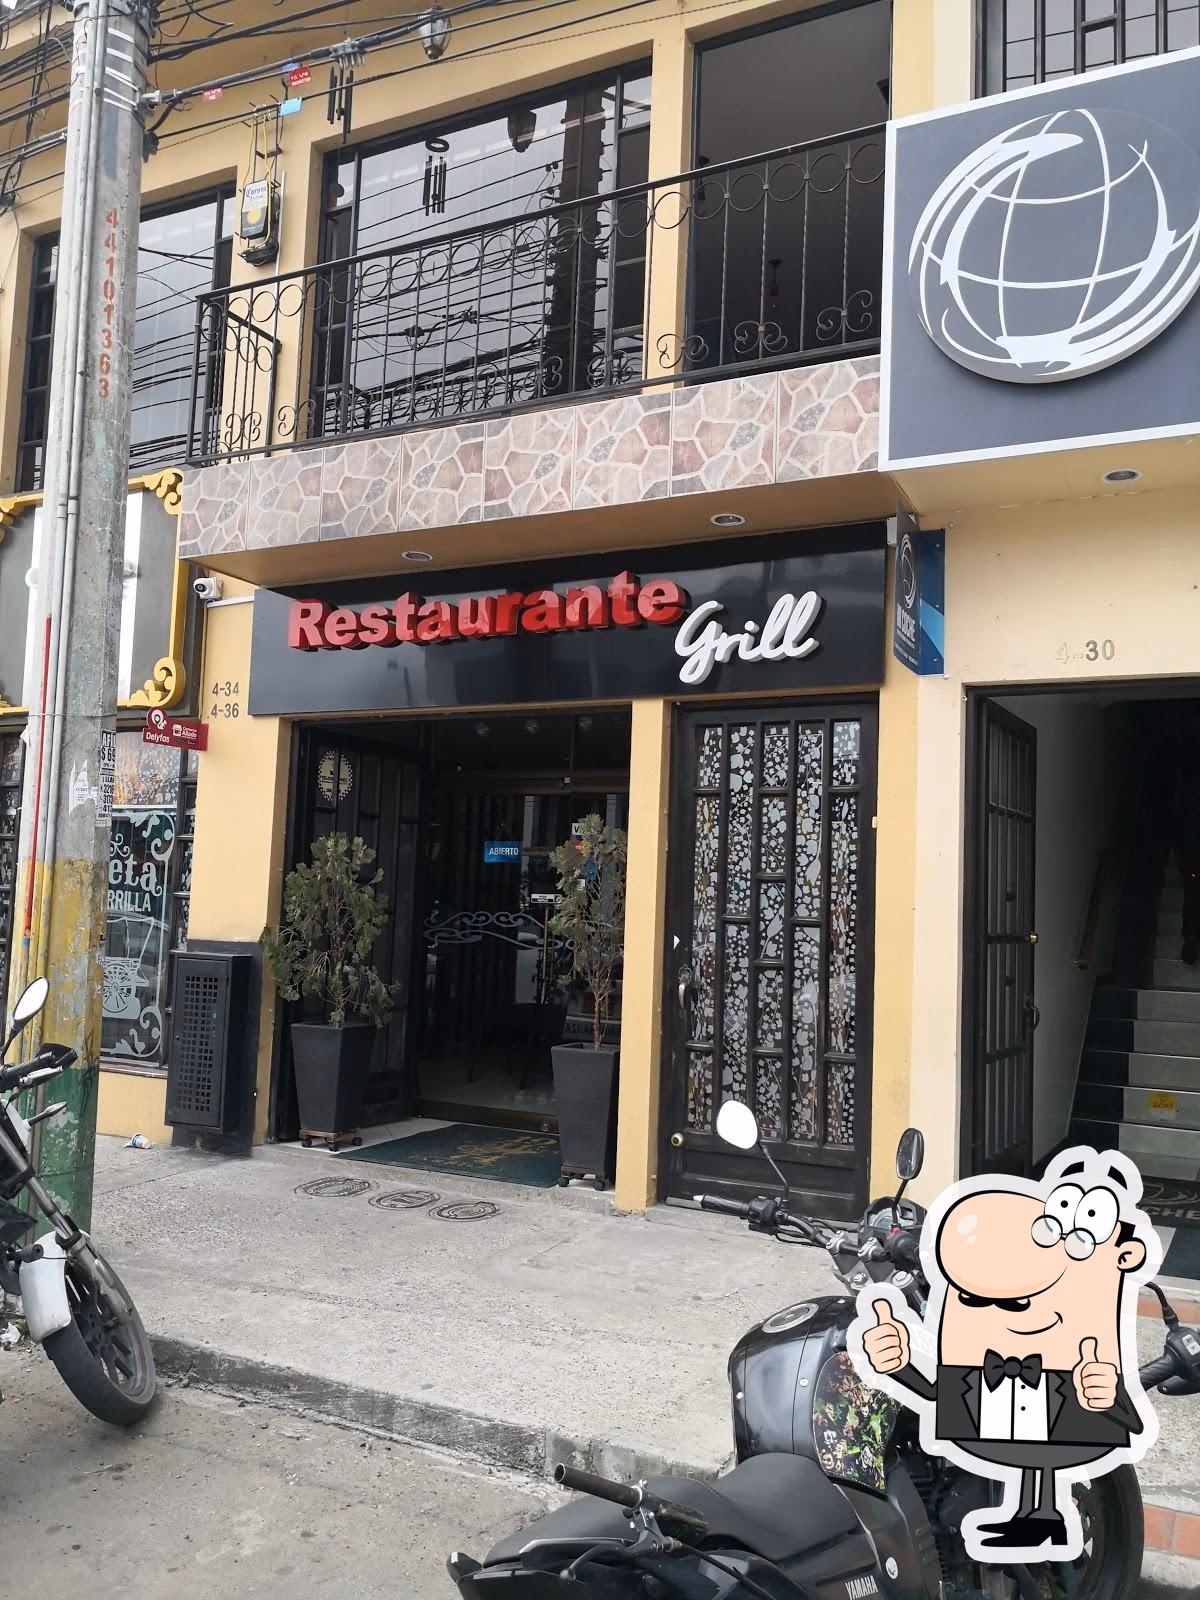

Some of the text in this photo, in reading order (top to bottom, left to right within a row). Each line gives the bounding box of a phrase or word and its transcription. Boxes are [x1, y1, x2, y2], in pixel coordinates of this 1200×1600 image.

[98, 207, 119, 400] 44101363
[287, 570, 820, 685] Restaurante Grill
[211, 681, 240, 697] 4-34
[210, 702, 240, 718] 4-36
[488, 847, 519, 856] ABIERTO
[108, 853, 163, 897] eta
[107, 889, 152, 912] RRILLA
[1142, 1206, 1200, 1221] CHE
[845, 1575, 879, 1600] YAMAHA
